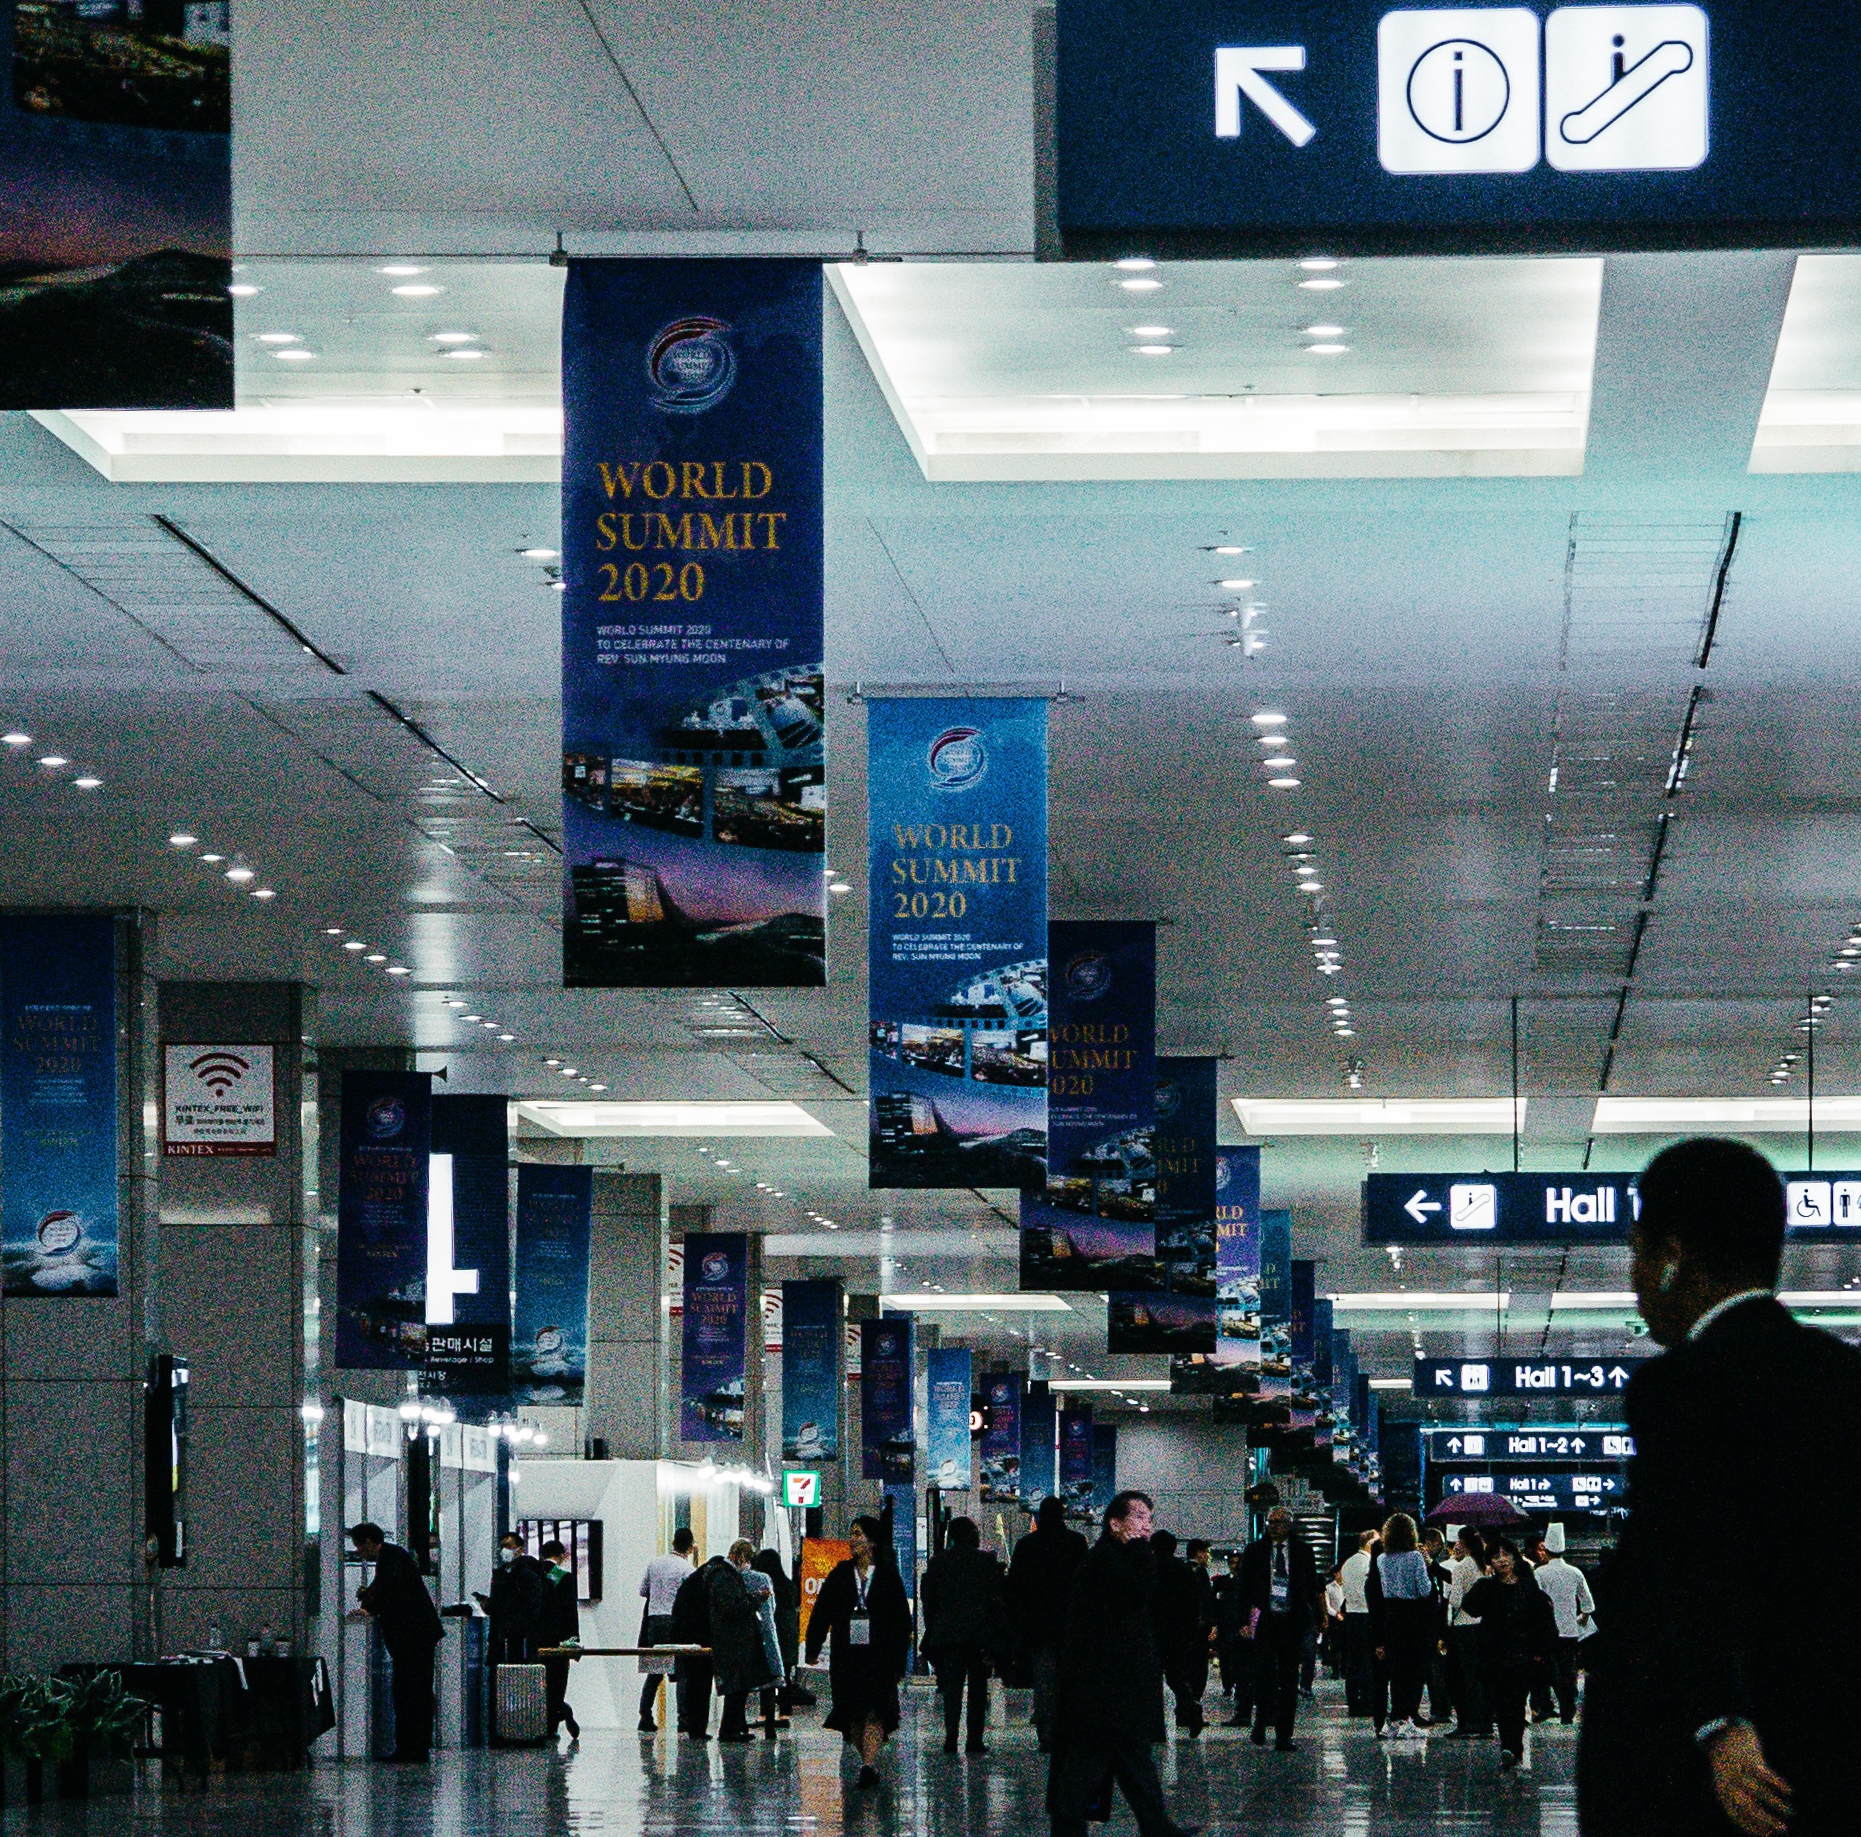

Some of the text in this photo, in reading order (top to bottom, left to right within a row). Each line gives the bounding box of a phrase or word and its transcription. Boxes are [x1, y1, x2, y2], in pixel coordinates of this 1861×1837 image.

[596, 460, 773, 499] WORLD
[595, 512, 787, 551] SUMMIT
[597, 562, 705, 602] 2020
[597, 625, 712, 635] WORLD SUMMIT 2020
[597, 639, 790, 650] TO CELEBRATE THE CENTENARY OF
[624, 653, 647, 664] SUN
[692, 653, 727, 664] MOON
[891, 823, 1012, 849] WORLD
[892, 858, 1021, 884] SUMMIT
[894, 891, 967, 918] 2020
[1051, 1050, 1137, 1070] UMMIT
[1051, 1075, 1094, 1095] 020
[167, 1145, 214, 1154] KINTEX
[1216, 1205, 1244, 1220] RLD
[1546, 1187, 1615, 1222] Hall
[425, 1337, 492, 1352] 판매시설
[1515, 1366, 1605, 1388] Hall 1~3
[1508, 1436, 1569, 1454] Hall 1~2
[1509, 1478, 1530, 1491] Hall
